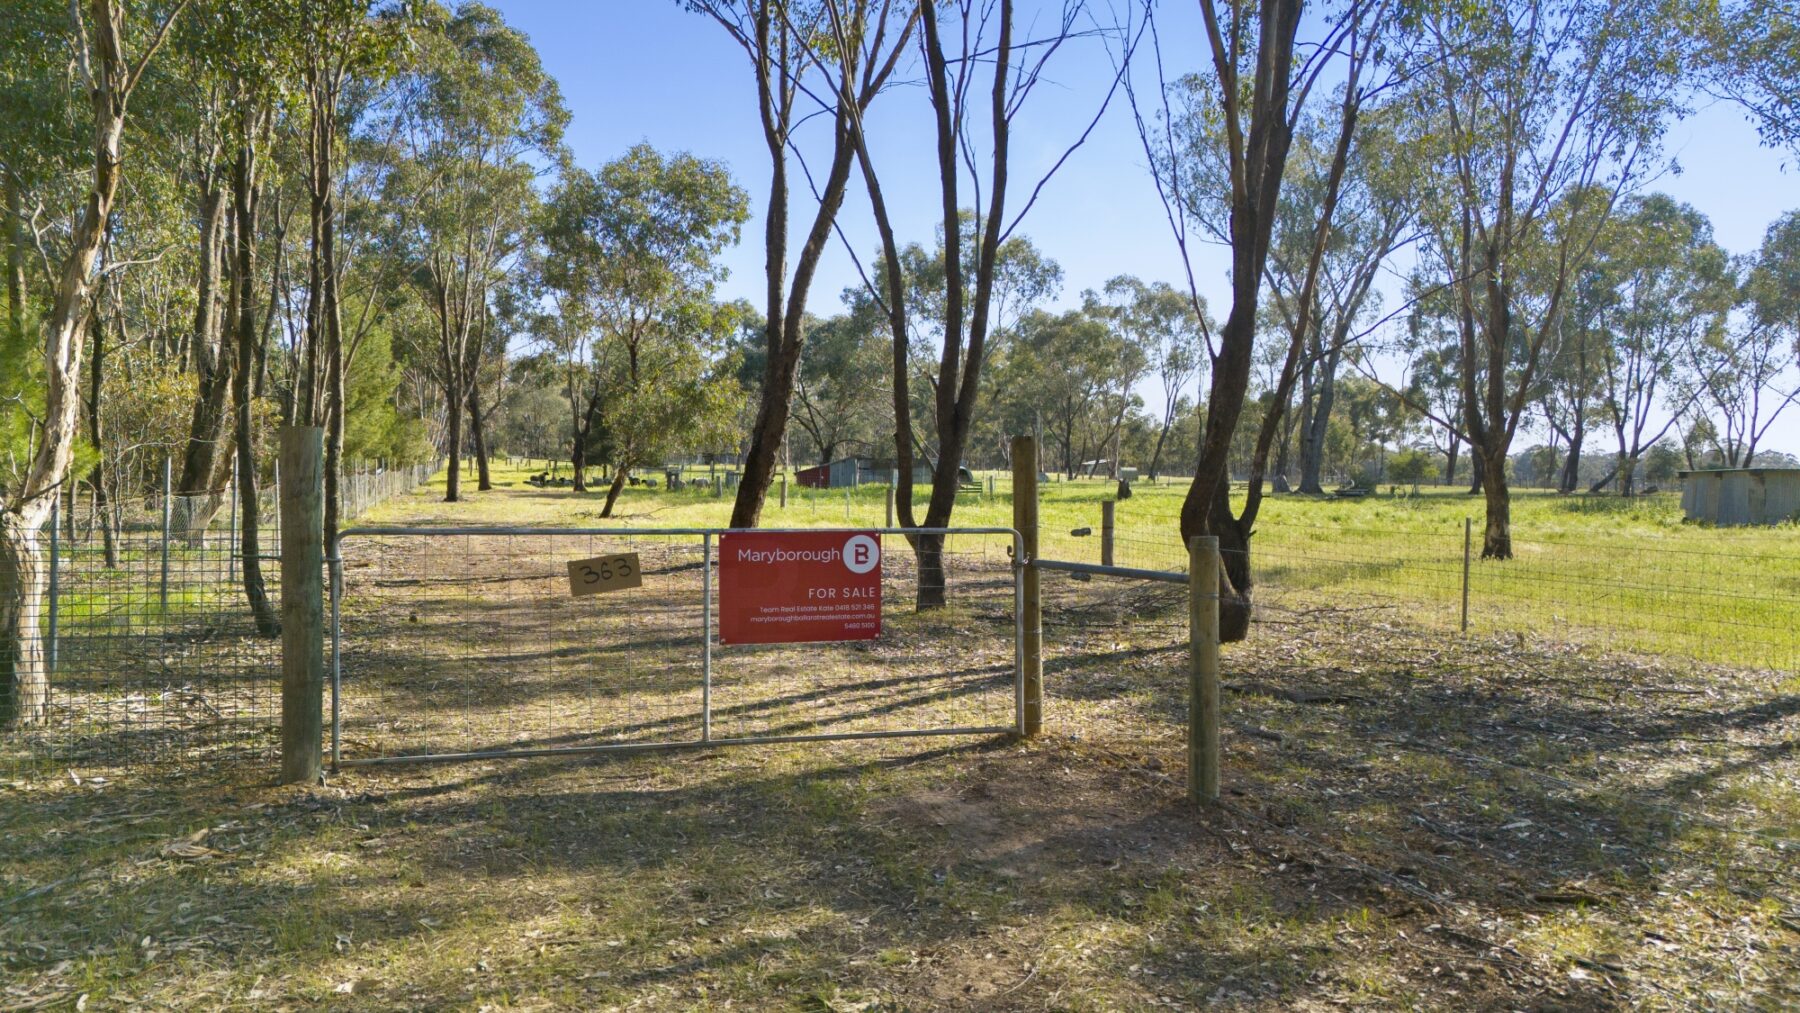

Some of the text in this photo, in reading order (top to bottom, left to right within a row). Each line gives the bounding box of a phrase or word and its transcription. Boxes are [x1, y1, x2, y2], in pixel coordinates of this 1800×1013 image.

[738, 548, 840, 563] Maryborough
[579, 558, 632, 584] 363
[808, 587, 875, 599] FOR SALE
[780, 605, 796, 613] Real
[818, 604, 834, 612] Kate
